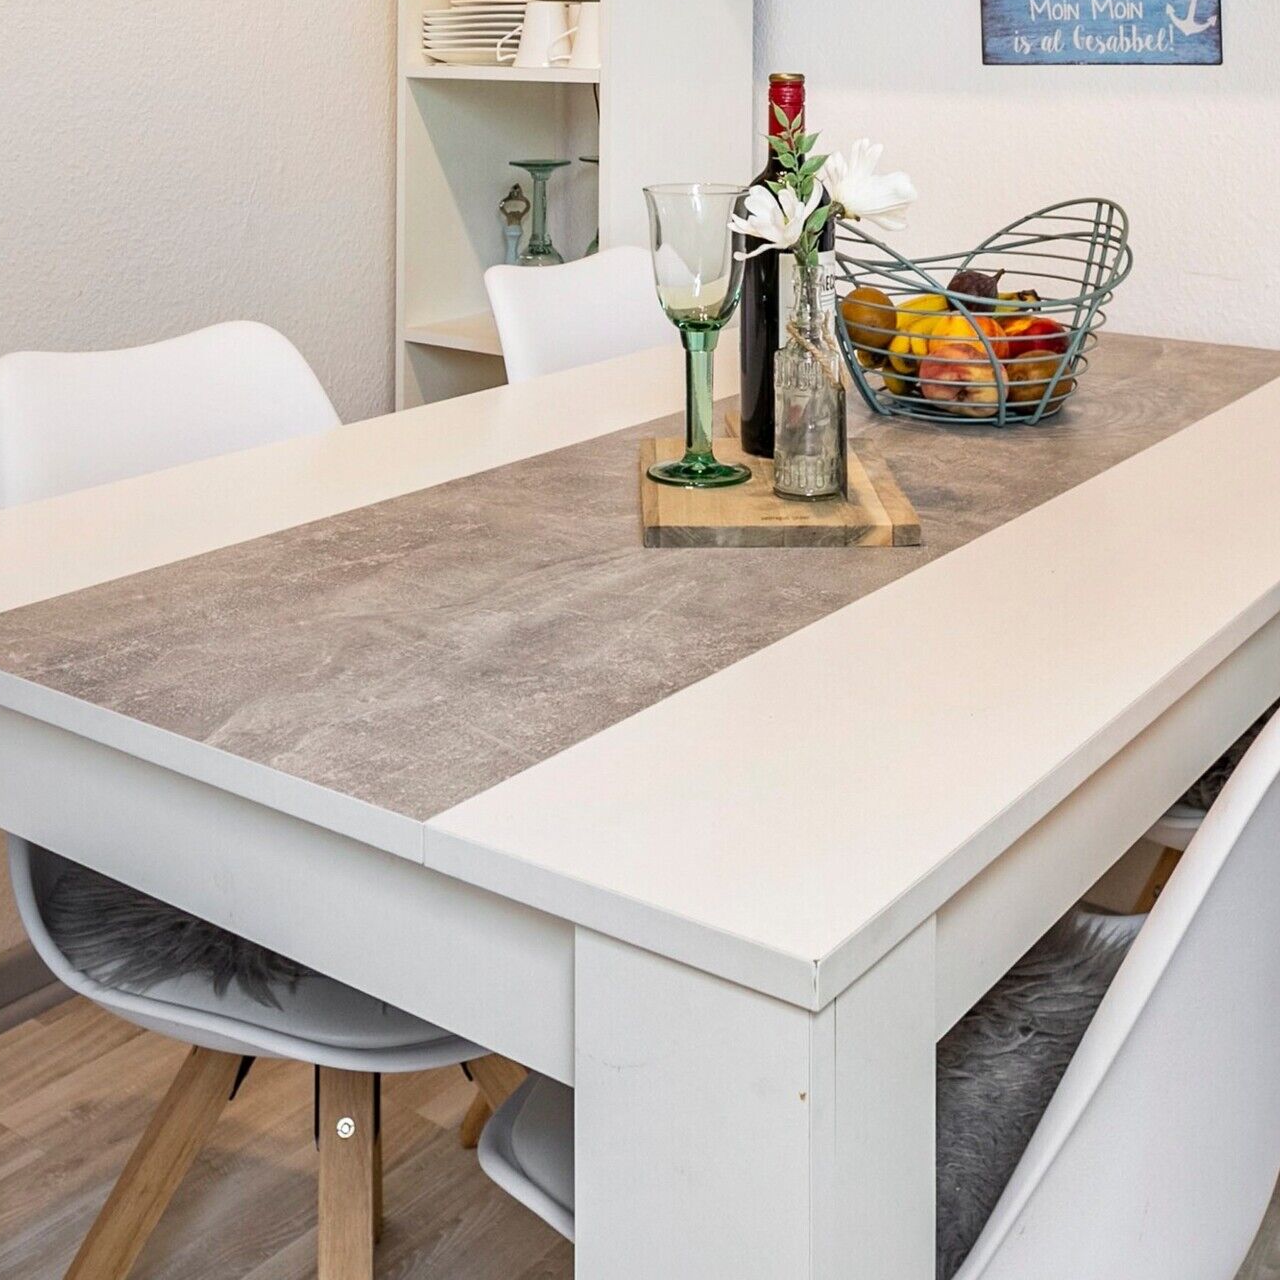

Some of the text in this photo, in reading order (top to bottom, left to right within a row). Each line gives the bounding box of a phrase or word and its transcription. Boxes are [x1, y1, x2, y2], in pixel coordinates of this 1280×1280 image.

[1014, 23, 1175, 54] is al Gesabbel!
